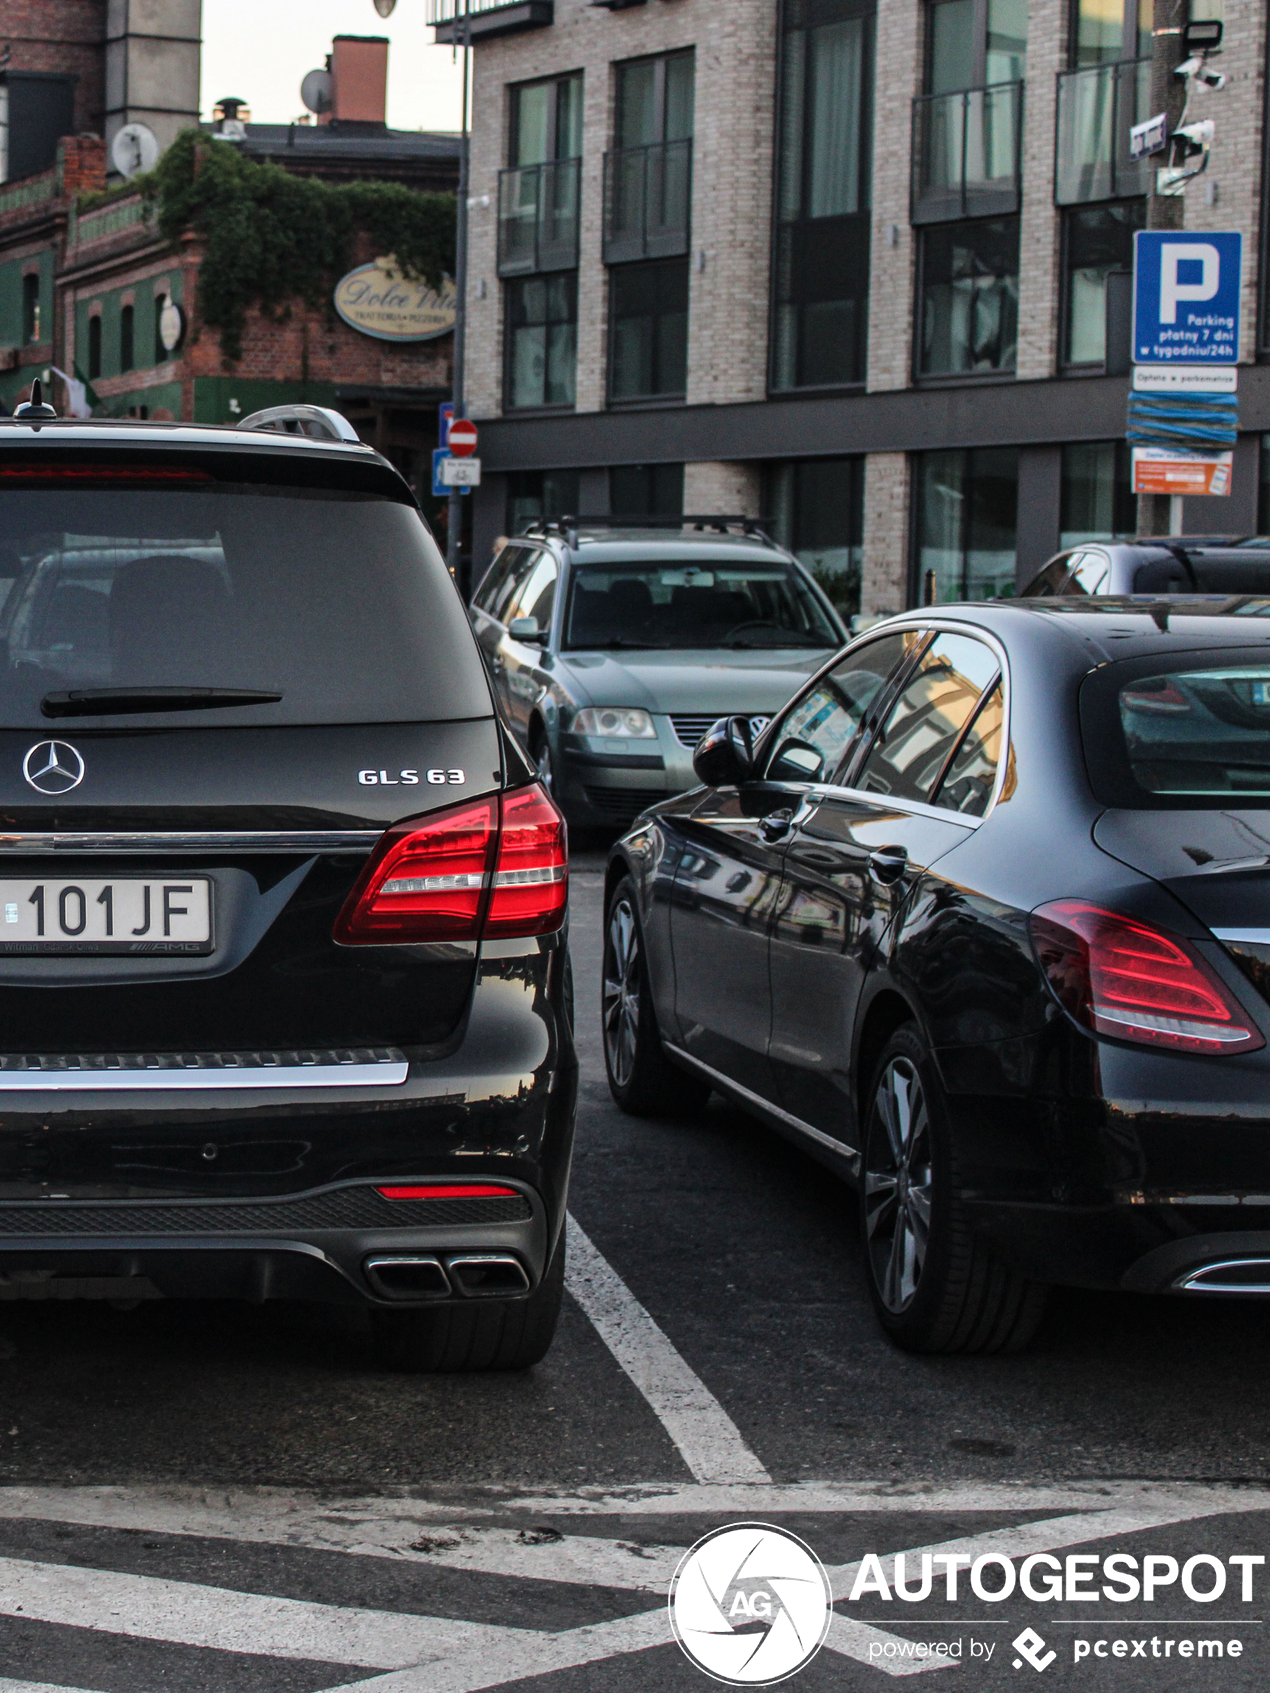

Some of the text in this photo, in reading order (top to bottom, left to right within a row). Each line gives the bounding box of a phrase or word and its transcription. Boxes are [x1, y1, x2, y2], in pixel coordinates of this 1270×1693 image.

[1159, 242, 1220, 324] P
[342, 280, 410, 307] Dolce
[1187, 314, 1234, 329] Parking
[1159, 329, 1234, 343] płatny 7 dni
[1140, 345, 1234, 359] w tygodniu/24h
[358, 769, 466, 785] GLS 63
[28, 885, 193, 936] 101JF
[150, 942, 200, 951] AMG
